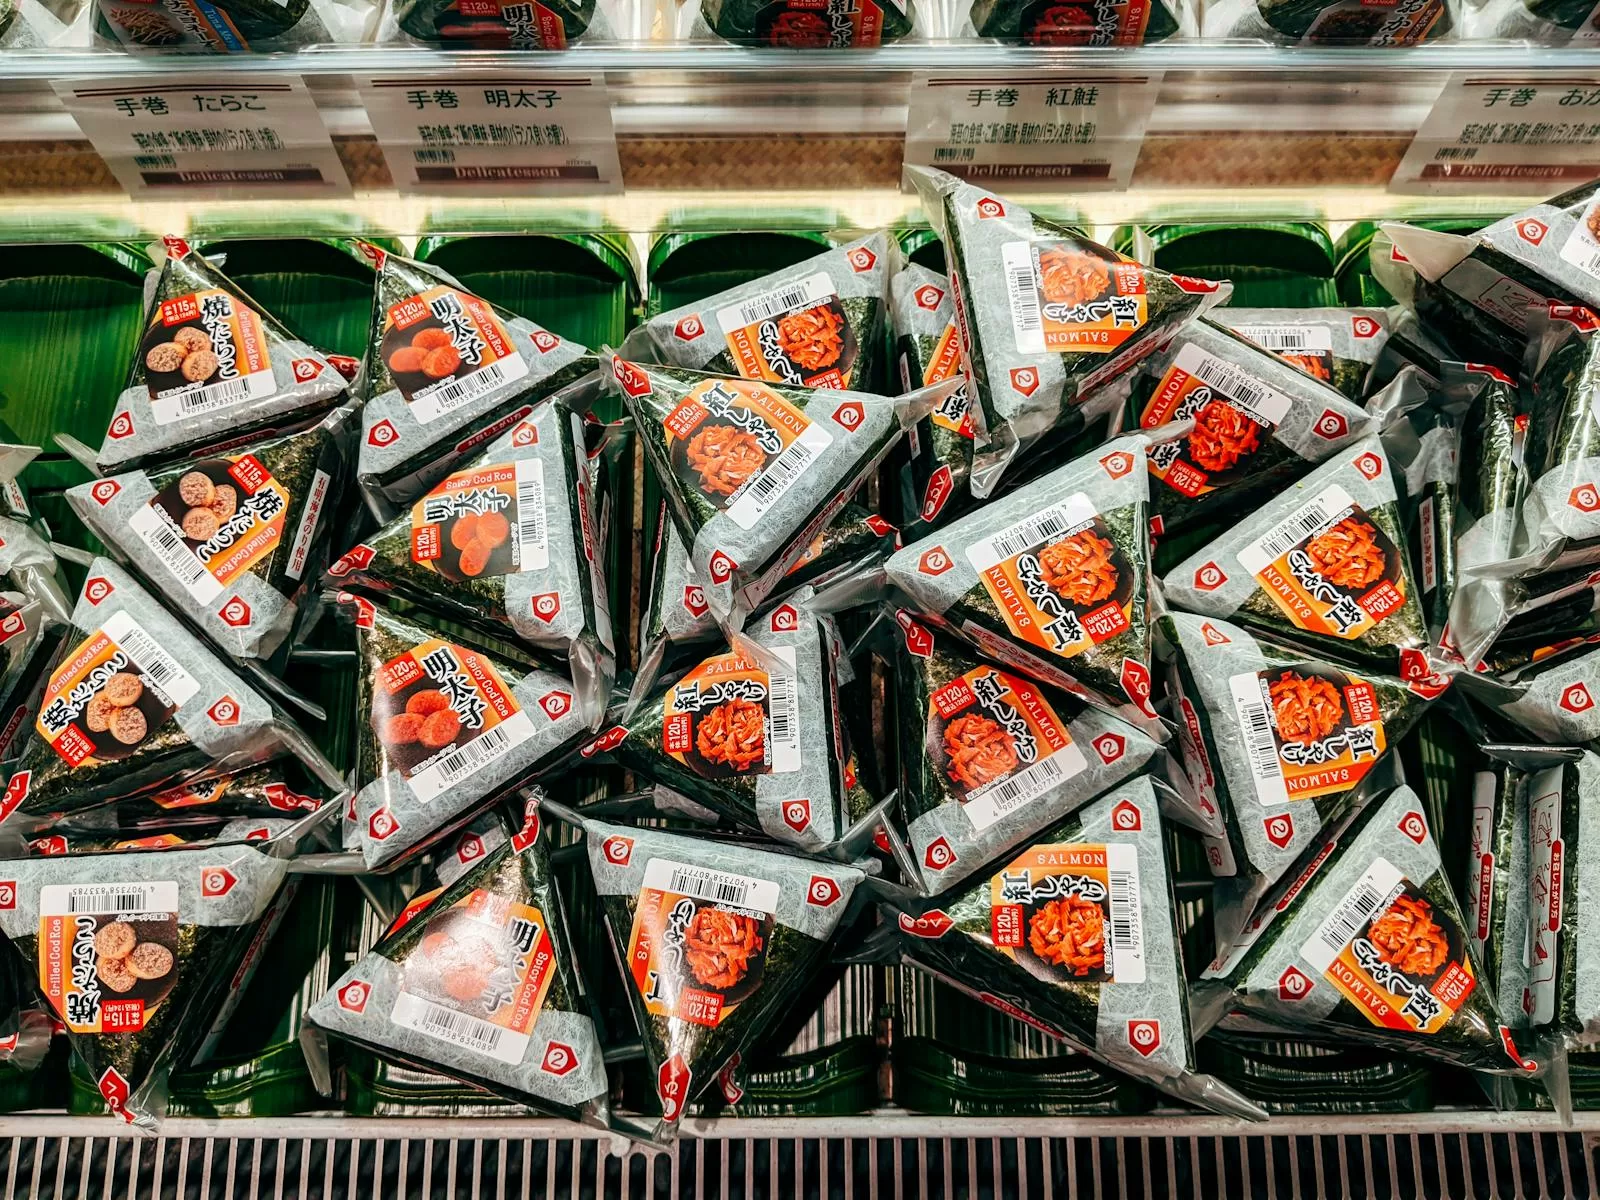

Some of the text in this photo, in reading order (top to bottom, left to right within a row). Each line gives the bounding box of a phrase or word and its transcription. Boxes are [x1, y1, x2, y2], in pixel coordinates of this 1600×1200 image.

[114, 93, 267, 117] 手巻 たらこ
[406, 88, 563, 109] 手巻 明太子
[966, 85, 1099, 107] 手巻 紅鮭
[1481, 87, 1537, 108] 手巻
[178, 170, 284, 182] Delicatessen
[455, 166, 561, 179] Delicatessen
[966, 164, 1073, 177] Delicatessen
[1460, 164, 1566, 177] Delicatessen
[428, 291, 487, 366] 明太子
[1042, 295, 1142, 329] 紅しゃけ
[202, 295, 240, 380] 焼たらこ
[735, 331, 763, 381] ALMON
[1047, 331, 1109, 344] SALMON
[701, 380, 784, 455] 紅しゃけ
[750, 390, 804, 434] SALMON
[1147, 370, 1188, 427] SALMON
[473, 473, 493, 485] Cod
[494, 471, 513, 482] Roe
[196, 486, 286, 564] 焼たらこ
[423, 485, 512, 524] 明太子
[989, 567, 1031, 628] SALMON
[1015, 552, 1086, 651] 紅しゃけ
[1263, 567, 1313, 620] SALMON
[1288, 548, 1366, 636] 紅しゃけ
[50, 665, 79, 694] Grilled
[419, 646, 489, 730] 明太子
[465, 655, 485, 682] Spicy
[41, 650, 129, 735] 焼たらこ
[671, 678, 768, 713] 紅しゃけ
[971, 670, 1040, 764] 紅しゃけ
[1020, 690, 1064, 749] SALMON
[1279, 726, 1381, 768] 紅しゃけ
[1287, 768, 1350, 791] SALMON
[1037, 853, 1105, 866] SALMON
[1000, 868, 1107, 906] 紅しゃけ
[50, 918, 62, 997] Grilled Cod Roe
[66, 916, 101, 1026] 焼たらこ
[528, 951, 549, 981] Spicy
[1331, 961, 1390, 1017] SALMON
[1351, 937, 1442, 1031] 紅しゃけ
